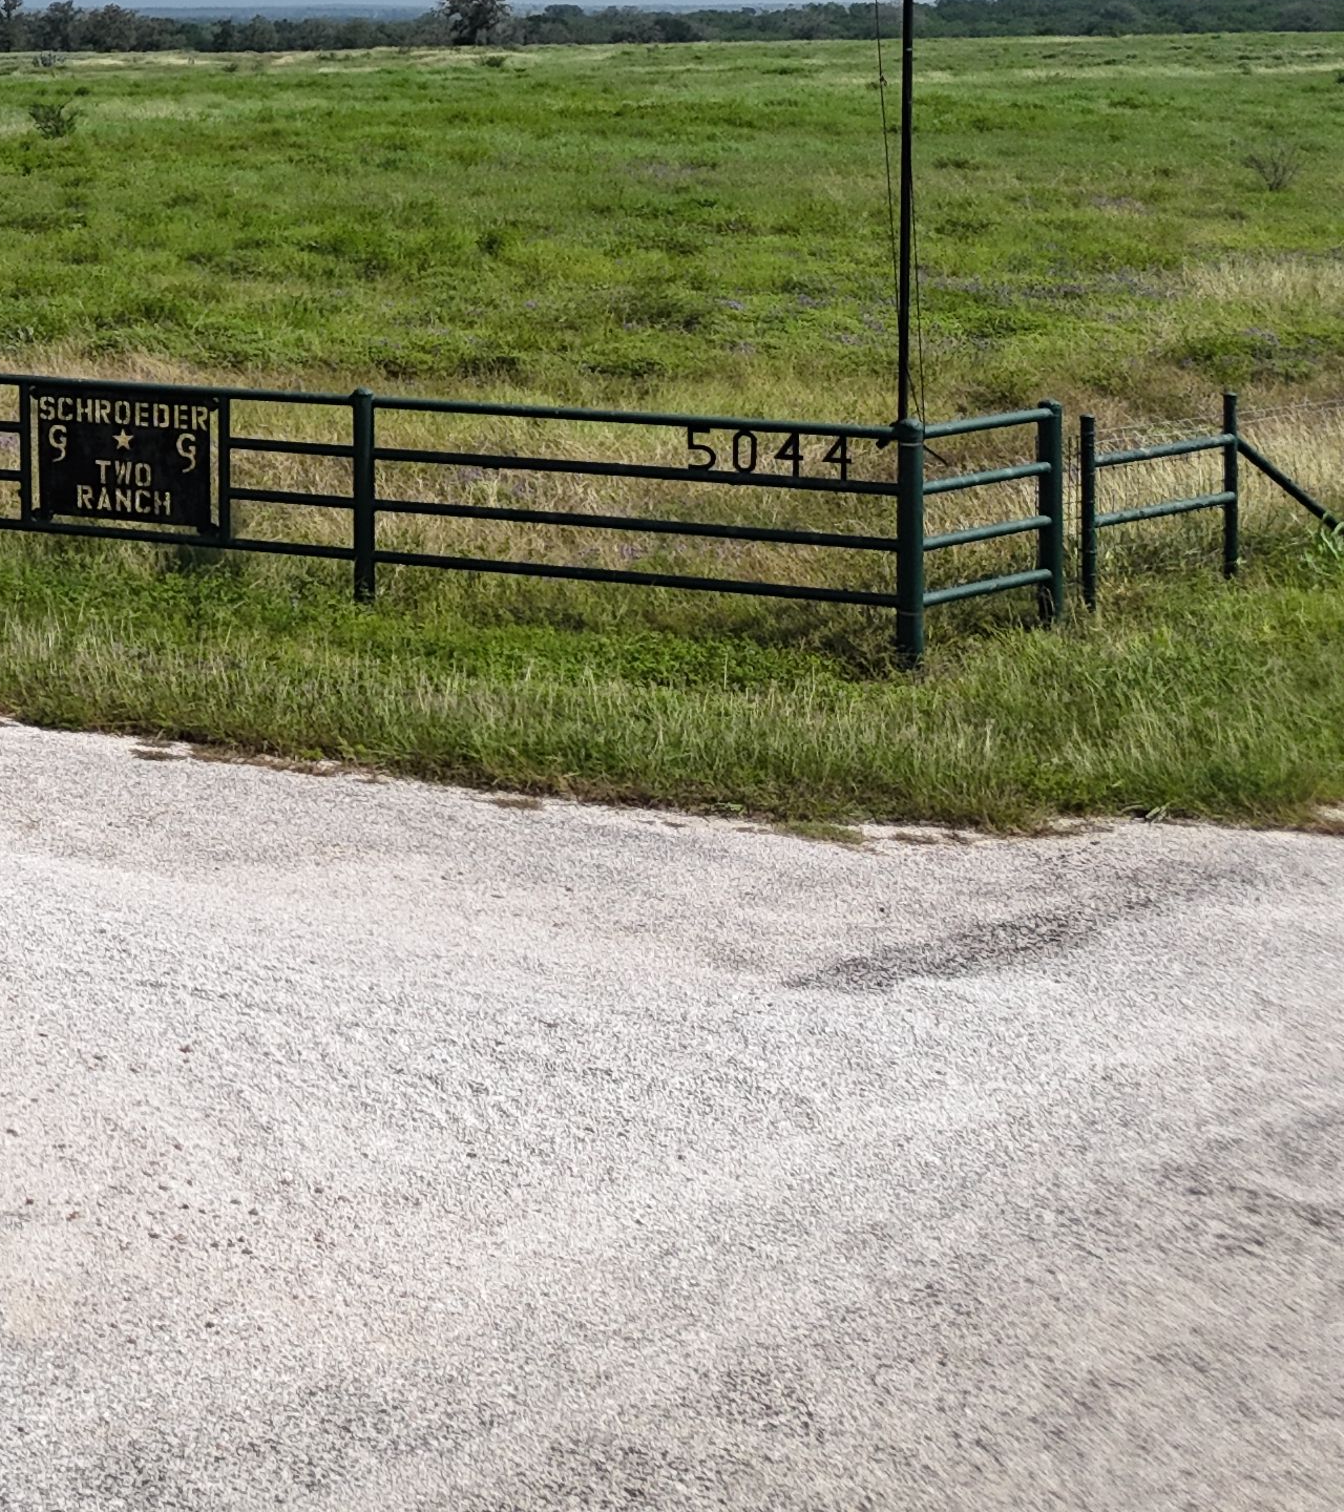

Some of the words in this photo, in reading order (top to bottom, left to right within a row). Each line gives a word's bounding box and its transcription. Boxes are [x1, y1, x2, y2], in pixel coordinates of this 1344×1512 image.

[39, 396, 209, 432] SCHROEDER
[687, 426, 852, 482] 5044
[94, 459, 152, 487] TWO
[76, 484, 172, 516] RANCH
